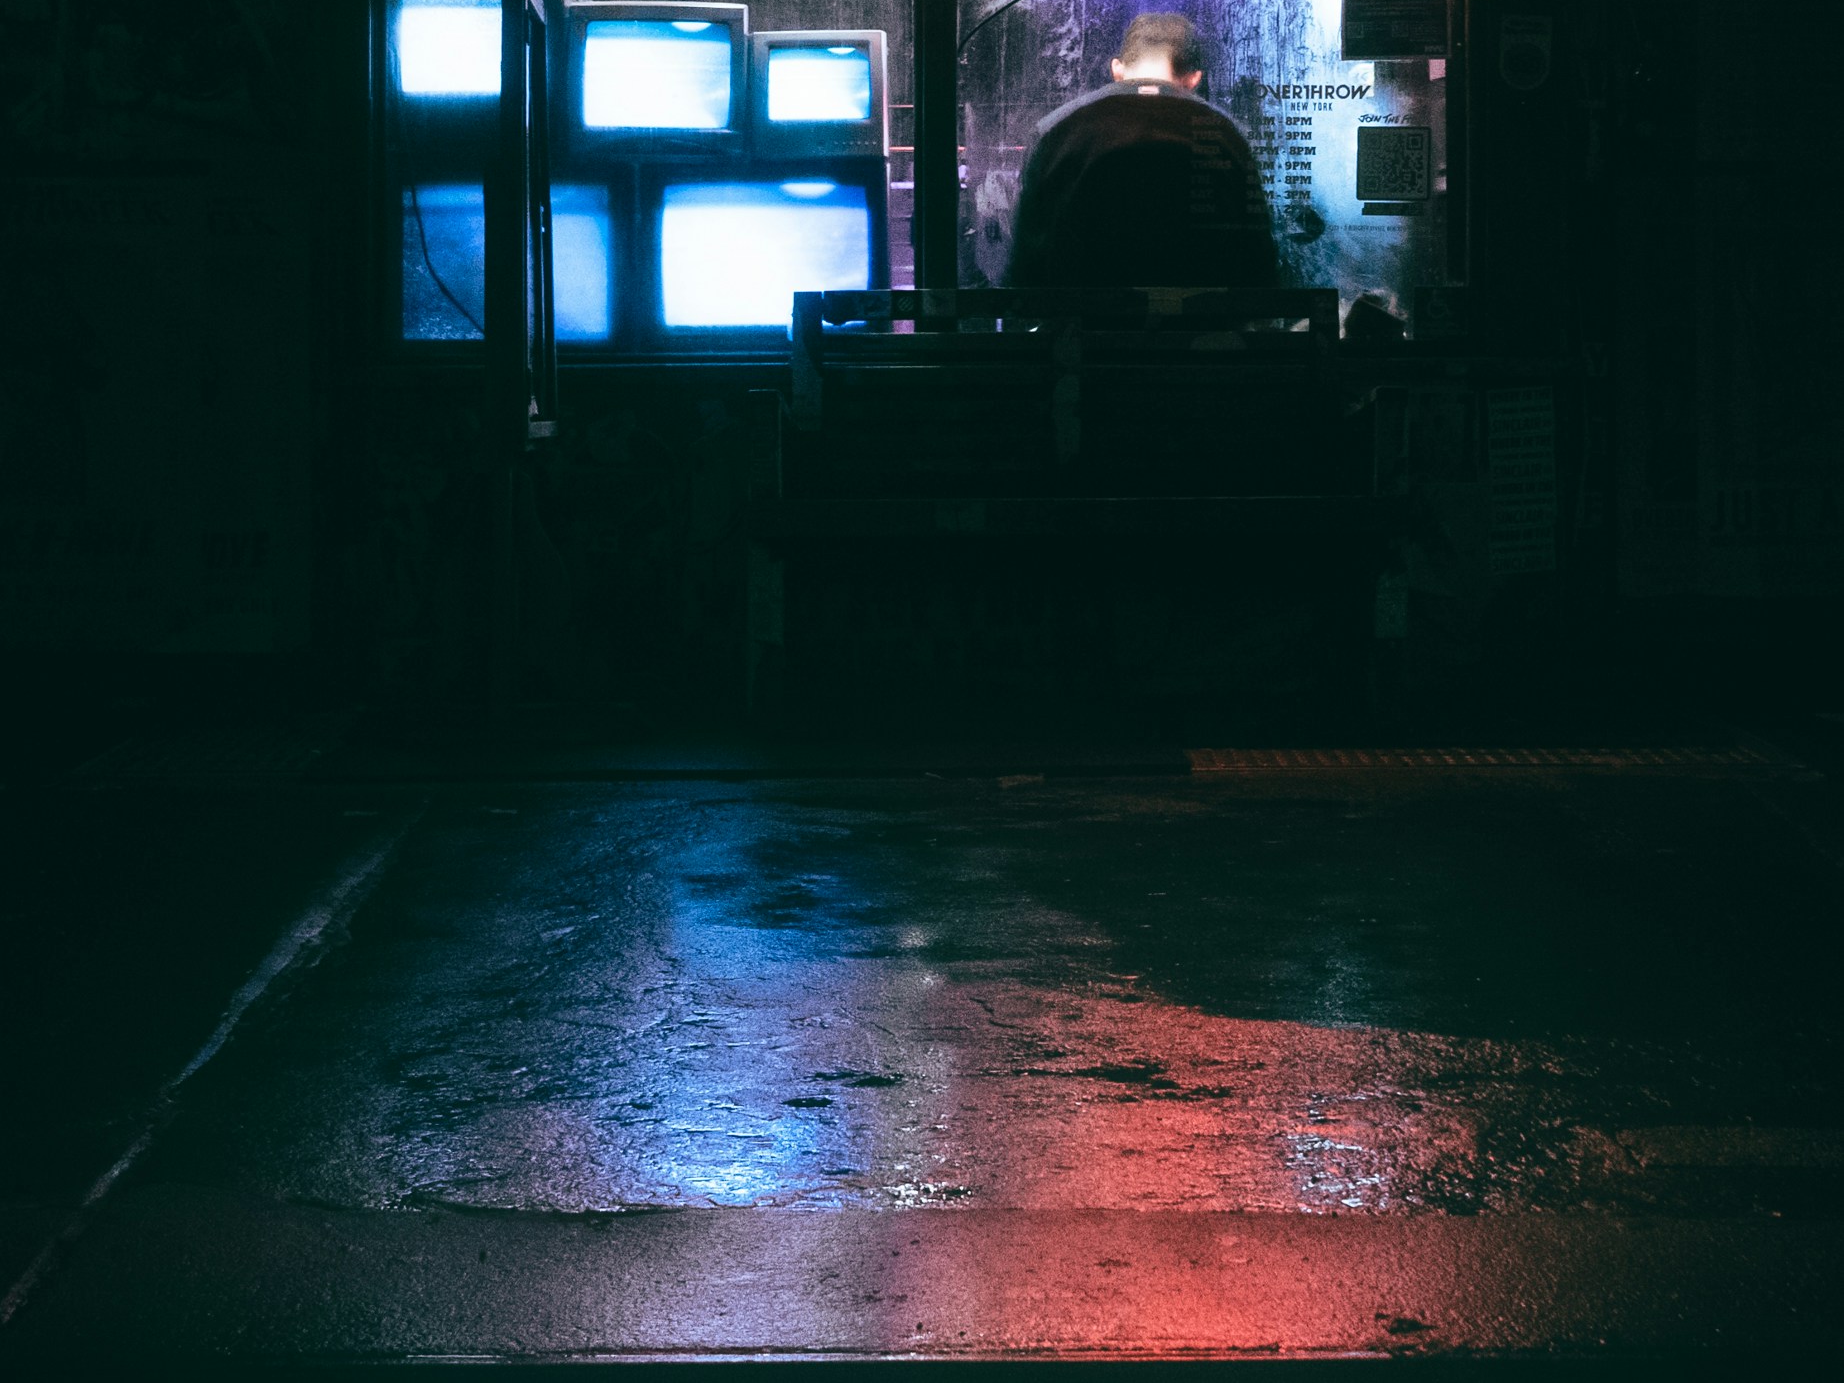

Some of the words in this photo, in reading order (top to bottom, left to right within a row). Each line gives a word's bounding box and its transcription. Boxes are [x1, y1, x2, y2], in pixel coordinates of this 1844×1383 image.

[1255, 84, 1371, 99] OVERTHROW
[1290, 102, 1309, 111] NEW
[1313, 102, 1333, 111] YORK
[1285, 117, 1313, 126] 8PM
[1358, 113, 1382, 123] JOIN
[1285, 131, 1312, 140] 9PM
[1289, 146, 1317, 155] 8PM
[1285, 161, 1312, 170] 9PM
[1284, 176, 1312, 185] 8PM
[1284, 190, 1311, 199] 3PM
